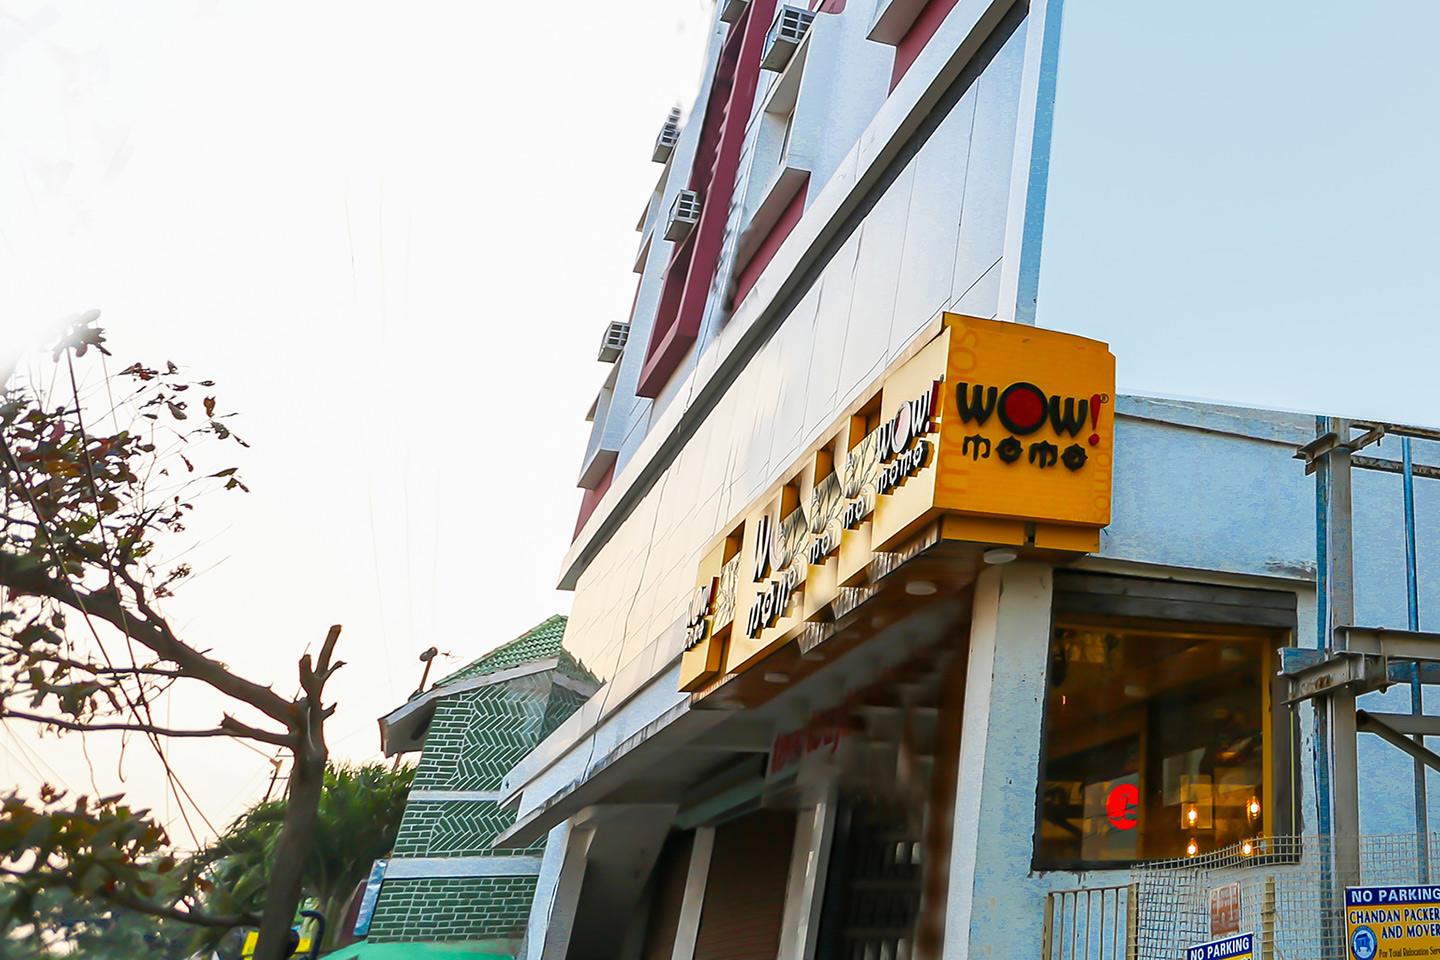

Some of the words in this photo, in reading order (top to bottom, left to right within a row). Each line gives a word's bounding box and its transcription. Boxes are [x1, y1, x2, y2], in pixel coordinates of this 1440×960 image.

[962, 434, 1089, 472] momo
[1351, 890, 1373, 903] NO
[1349, 909, 1401, 924] CHANDAN
[1381, 925, 1403, 939] AND
[1190, 948, 1204, 960] NO
[1207, 937, 1250, 959] PARKING
